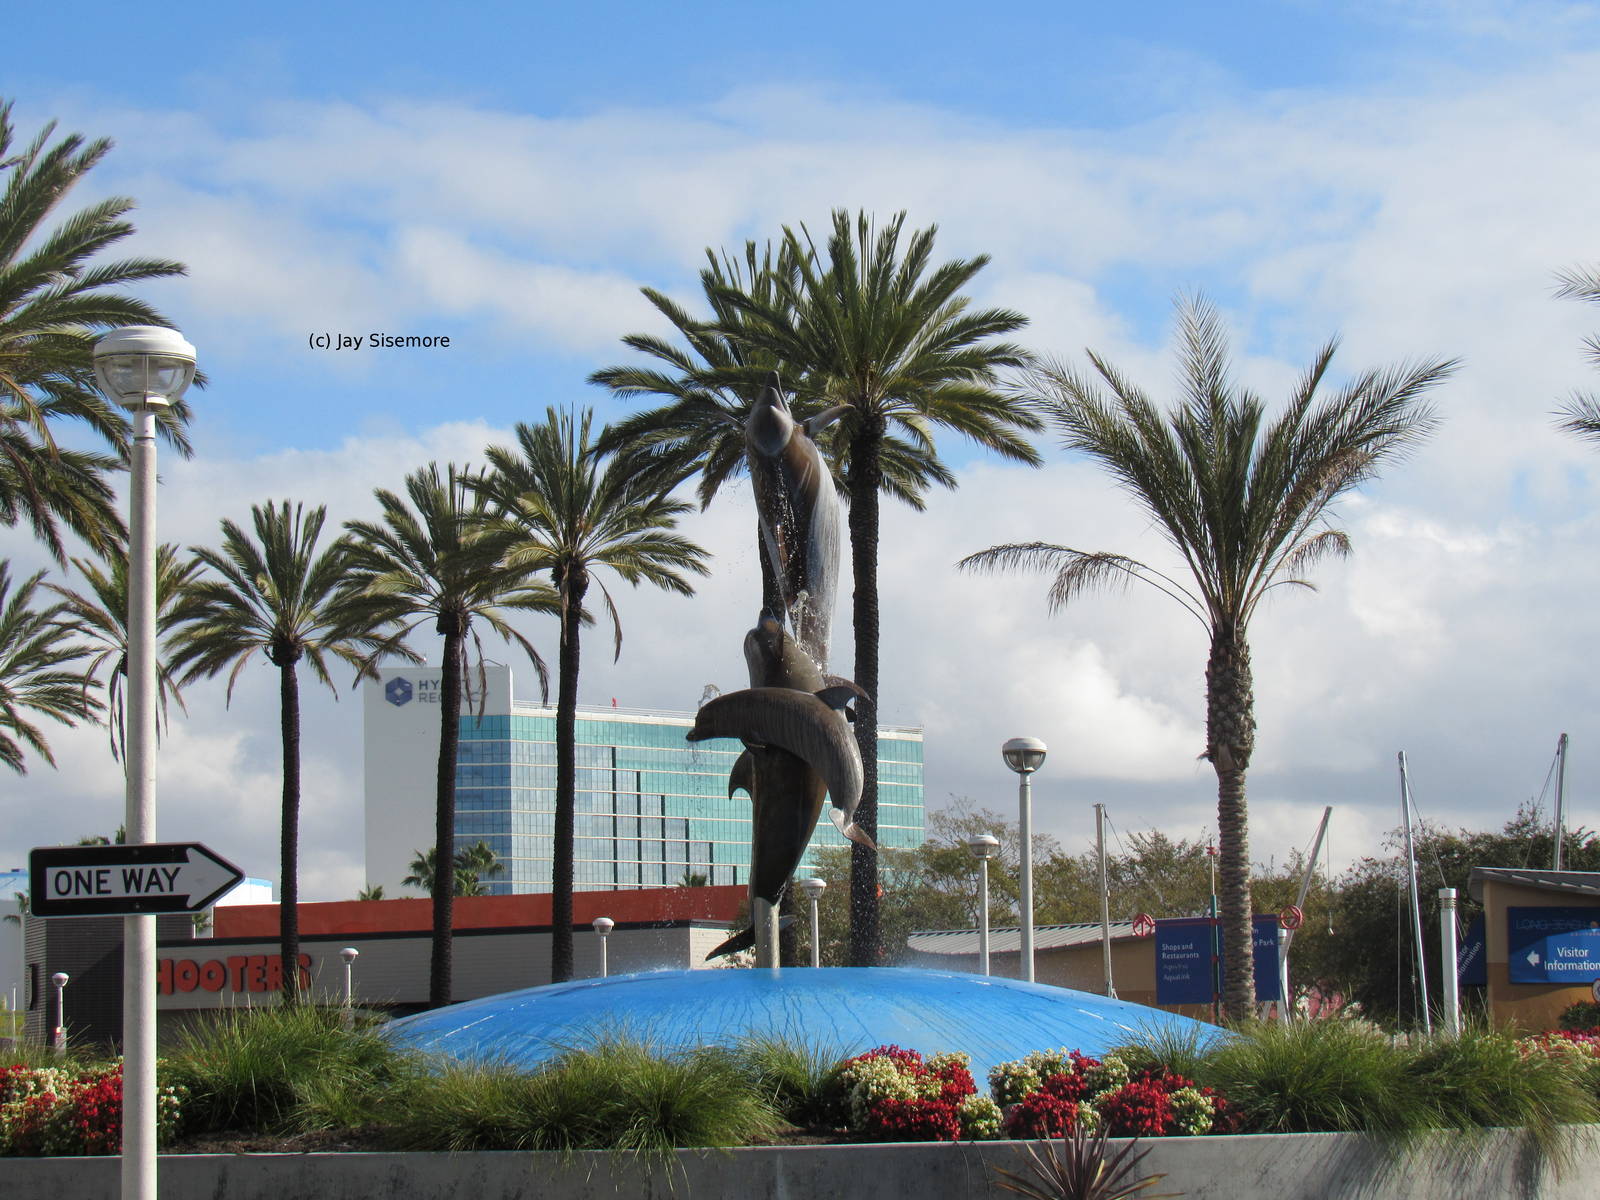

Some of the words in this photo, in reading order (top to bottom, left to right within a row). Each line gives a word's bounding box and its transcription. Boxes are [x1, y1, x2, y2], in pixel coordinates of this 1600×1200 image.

[55, 869, 112, 896] ONE
[122, 866, 181, 894] WAY
[1161, 943, 1181, 951] Shops
[1181, 942, 1193, 950] and
[1258, 938, 1274, 946] Park
[1557, 947, 1589, 957] Visitor
[1544, 960, 1600, 971] Information
